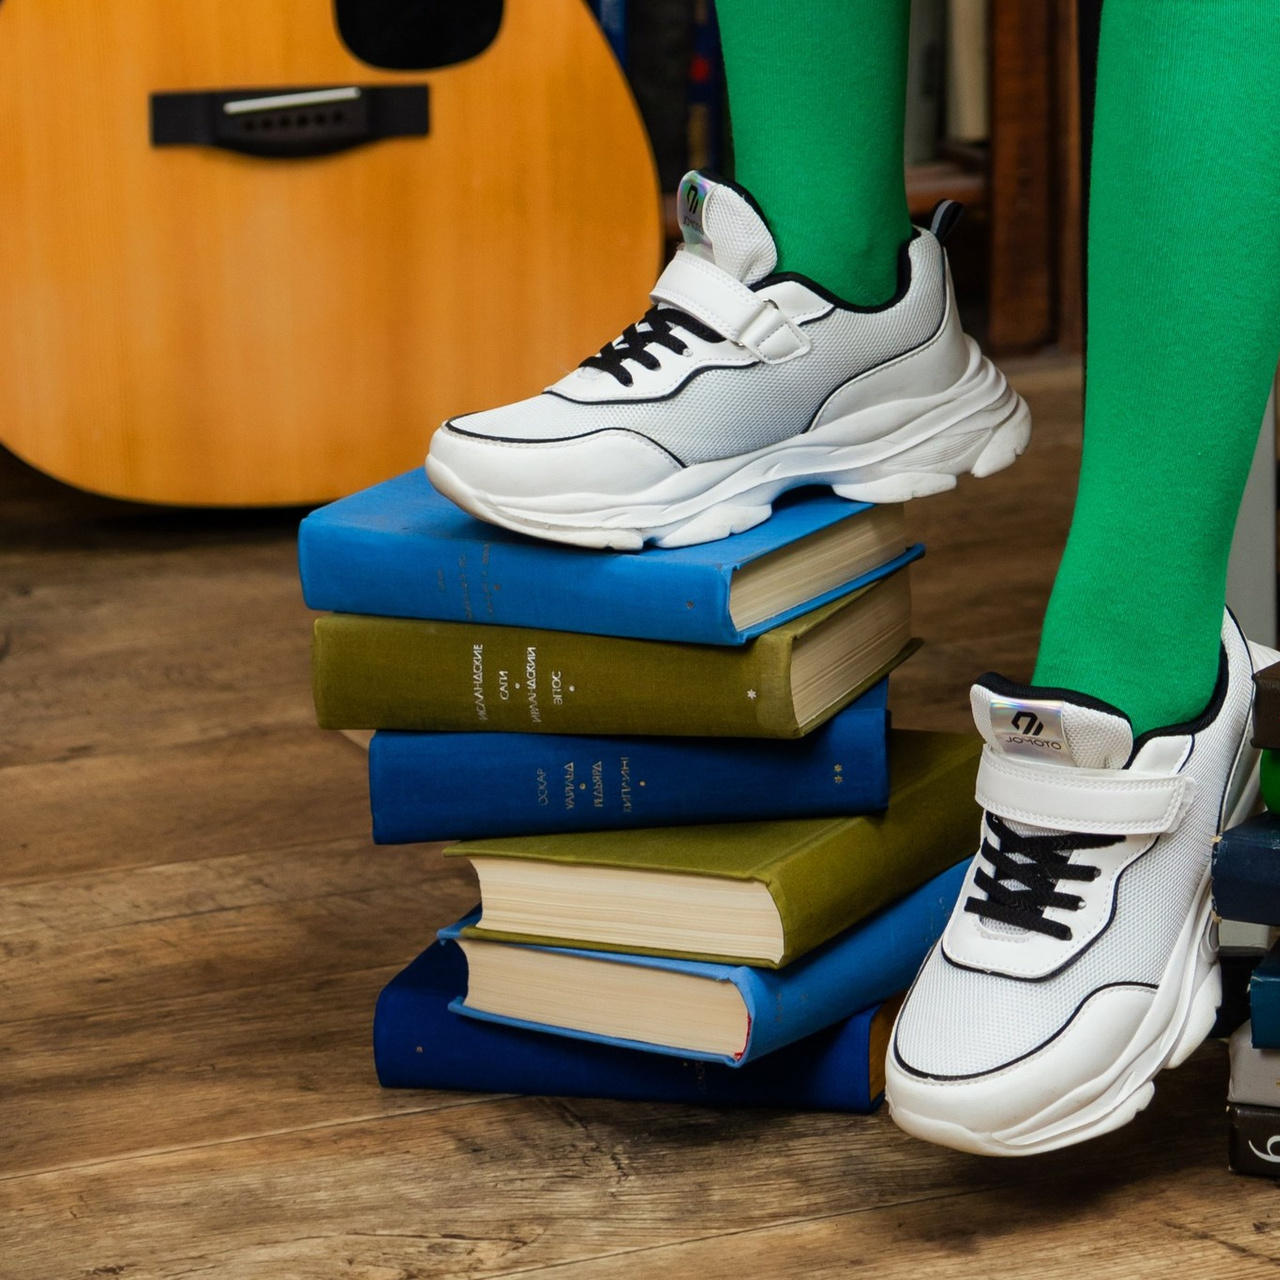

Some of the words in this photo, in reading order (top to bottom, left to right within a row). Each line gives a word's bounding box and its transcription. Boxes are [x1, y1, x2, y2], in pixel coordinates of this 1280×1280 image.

[473, 644, 488, 721] ИСЛАНДСКИЕ
[499, 670, 510, 700] САГИ
[551, 670, 563, 706] ЭПОС
[1005, 734, 1062, 751] JOMOTO
